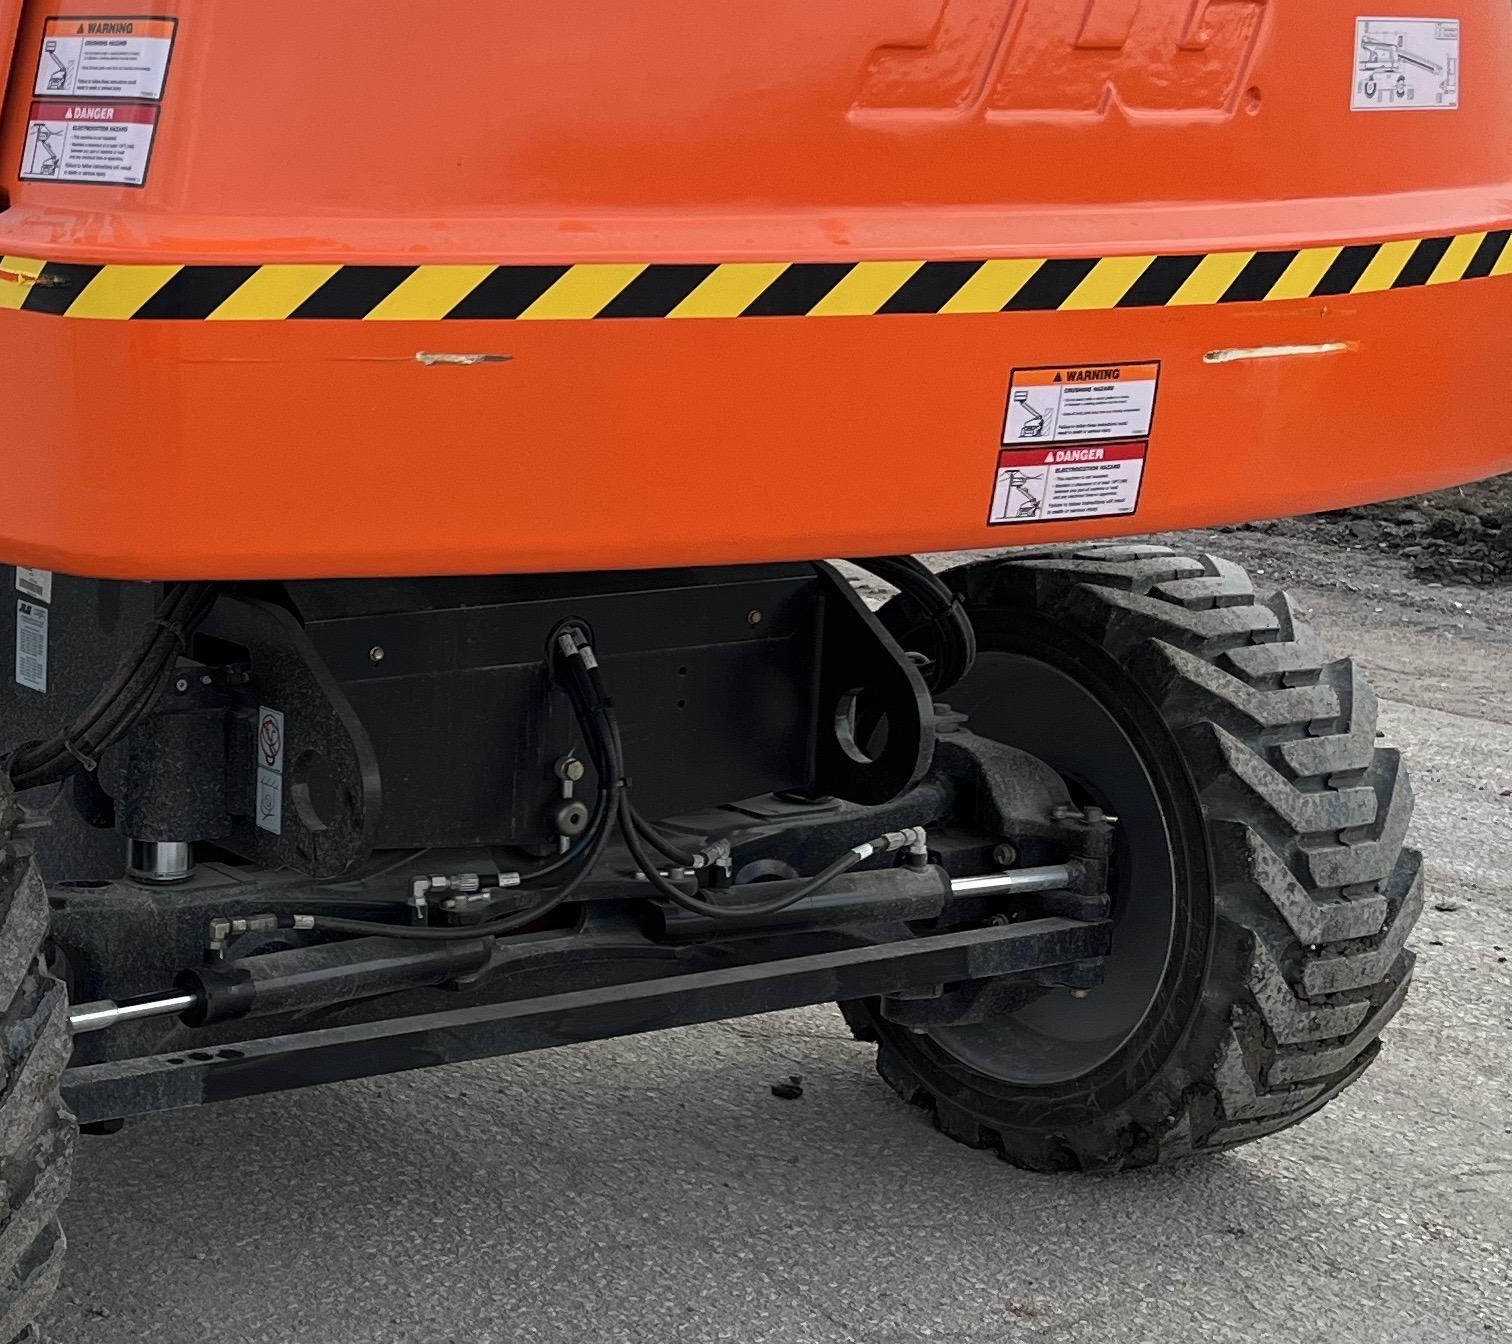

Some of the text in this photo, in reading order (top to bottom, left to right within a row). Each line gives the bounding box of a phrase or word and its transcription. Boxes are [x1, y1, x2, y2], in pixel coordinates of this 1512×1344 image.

[87, 22, 133, 34] WARNING
[73, 107, 114, 119] DANGER
[1066, 368, 1120, 382] WARNING
[1055, 448, 1104, 463] DANGER
